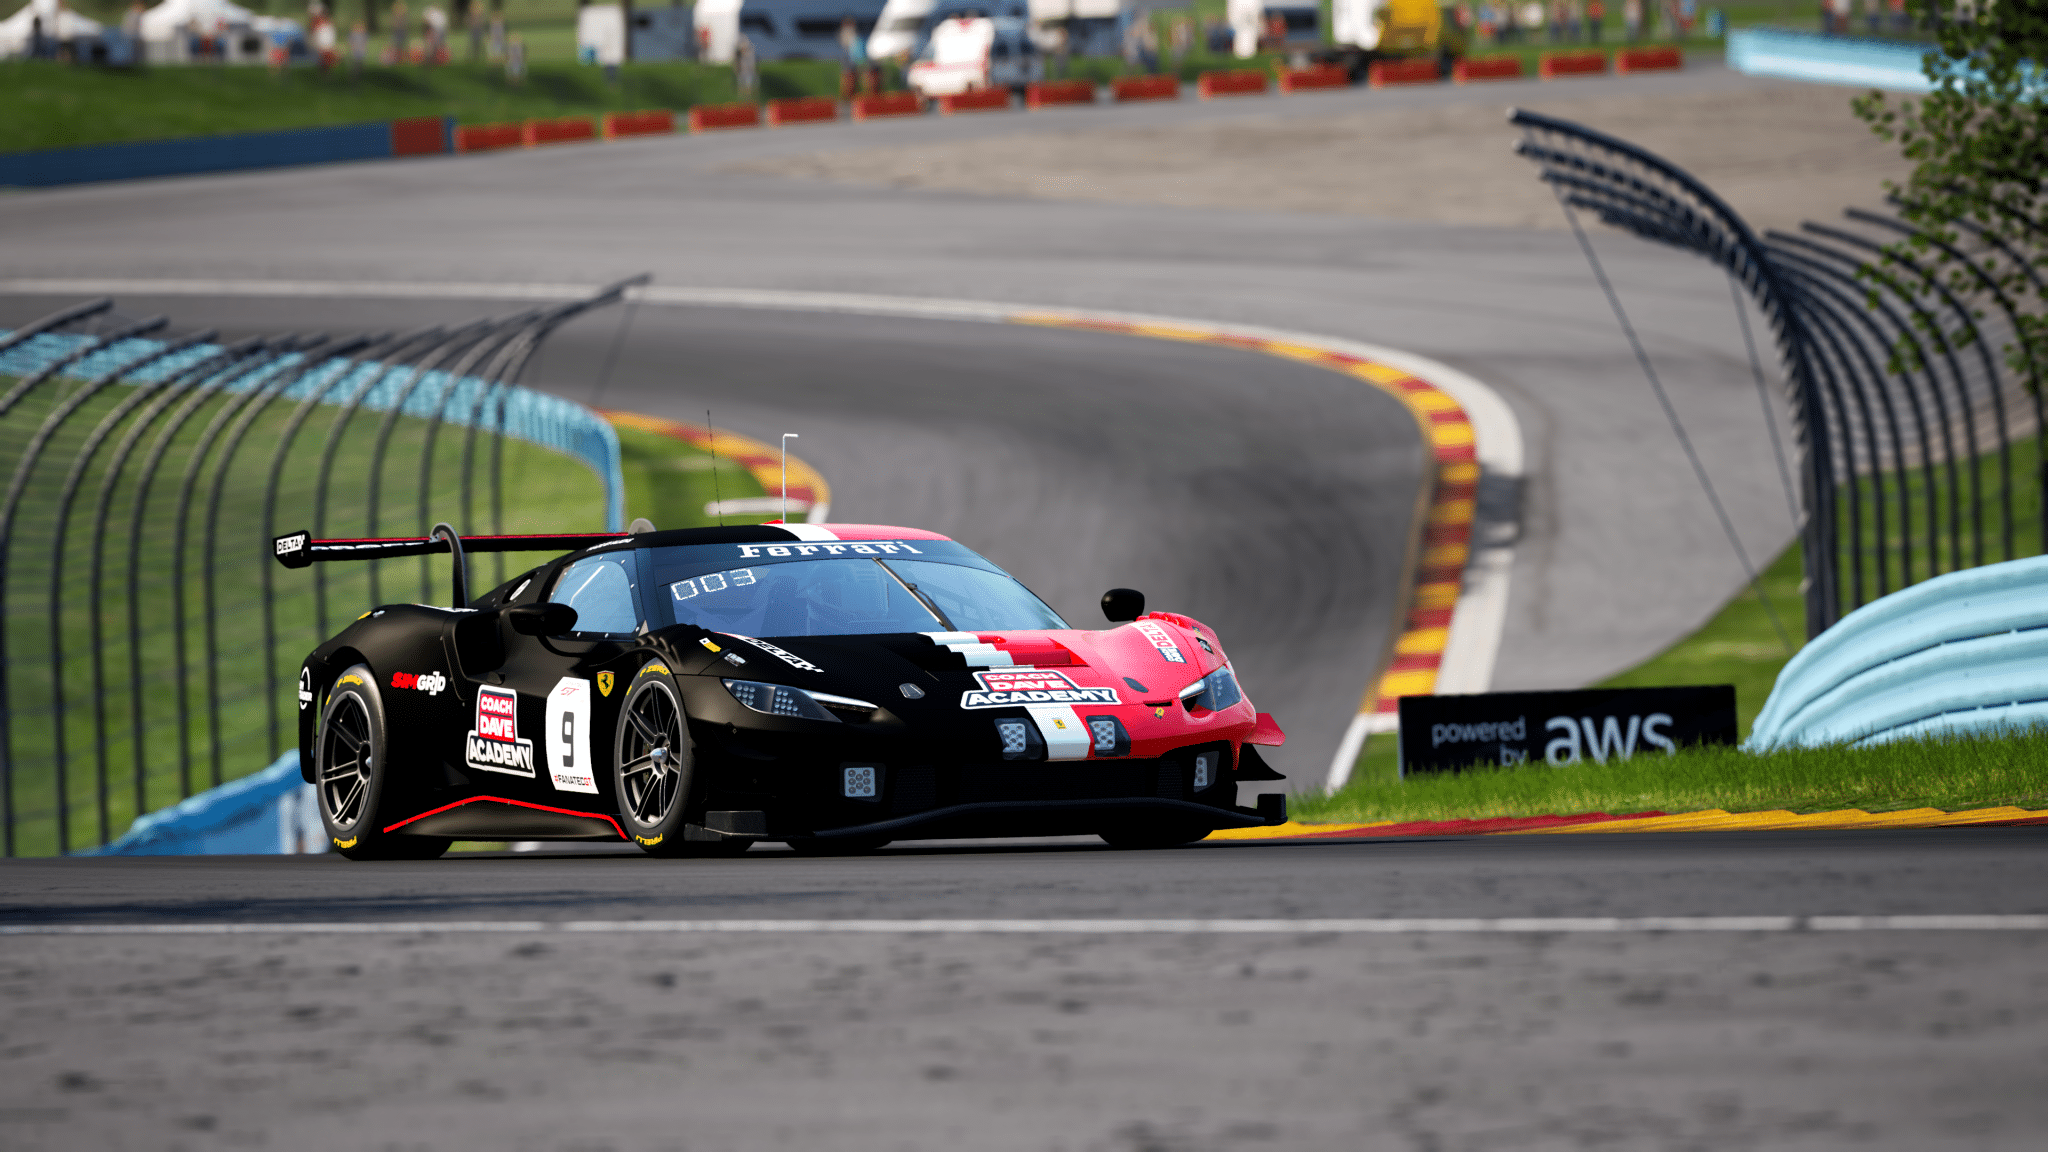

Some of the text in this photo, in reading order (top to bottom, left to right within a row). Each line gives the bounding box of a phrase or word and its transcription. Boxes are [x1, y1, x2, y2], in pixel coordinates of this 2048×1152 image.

[278, 538, 299, 552] DELTA
[737, 541, 924, 558] Ferrari
[670, 568, 757, 601] 003
[984, 673, 1060, 681] COACH
[989, 680, 1070, 690] DAVE
[480, 696, 513, 715] COACH
[968, 690, 1115, 706] ACADEMY
[480, 714, 514, 739] DAVE
[1431, 715, 1527, 749] powered
[562, 711, 574, 768] 9
[1545, 712, 1676, 768] aws
[469, 738, 532, 770] ACADEMY
